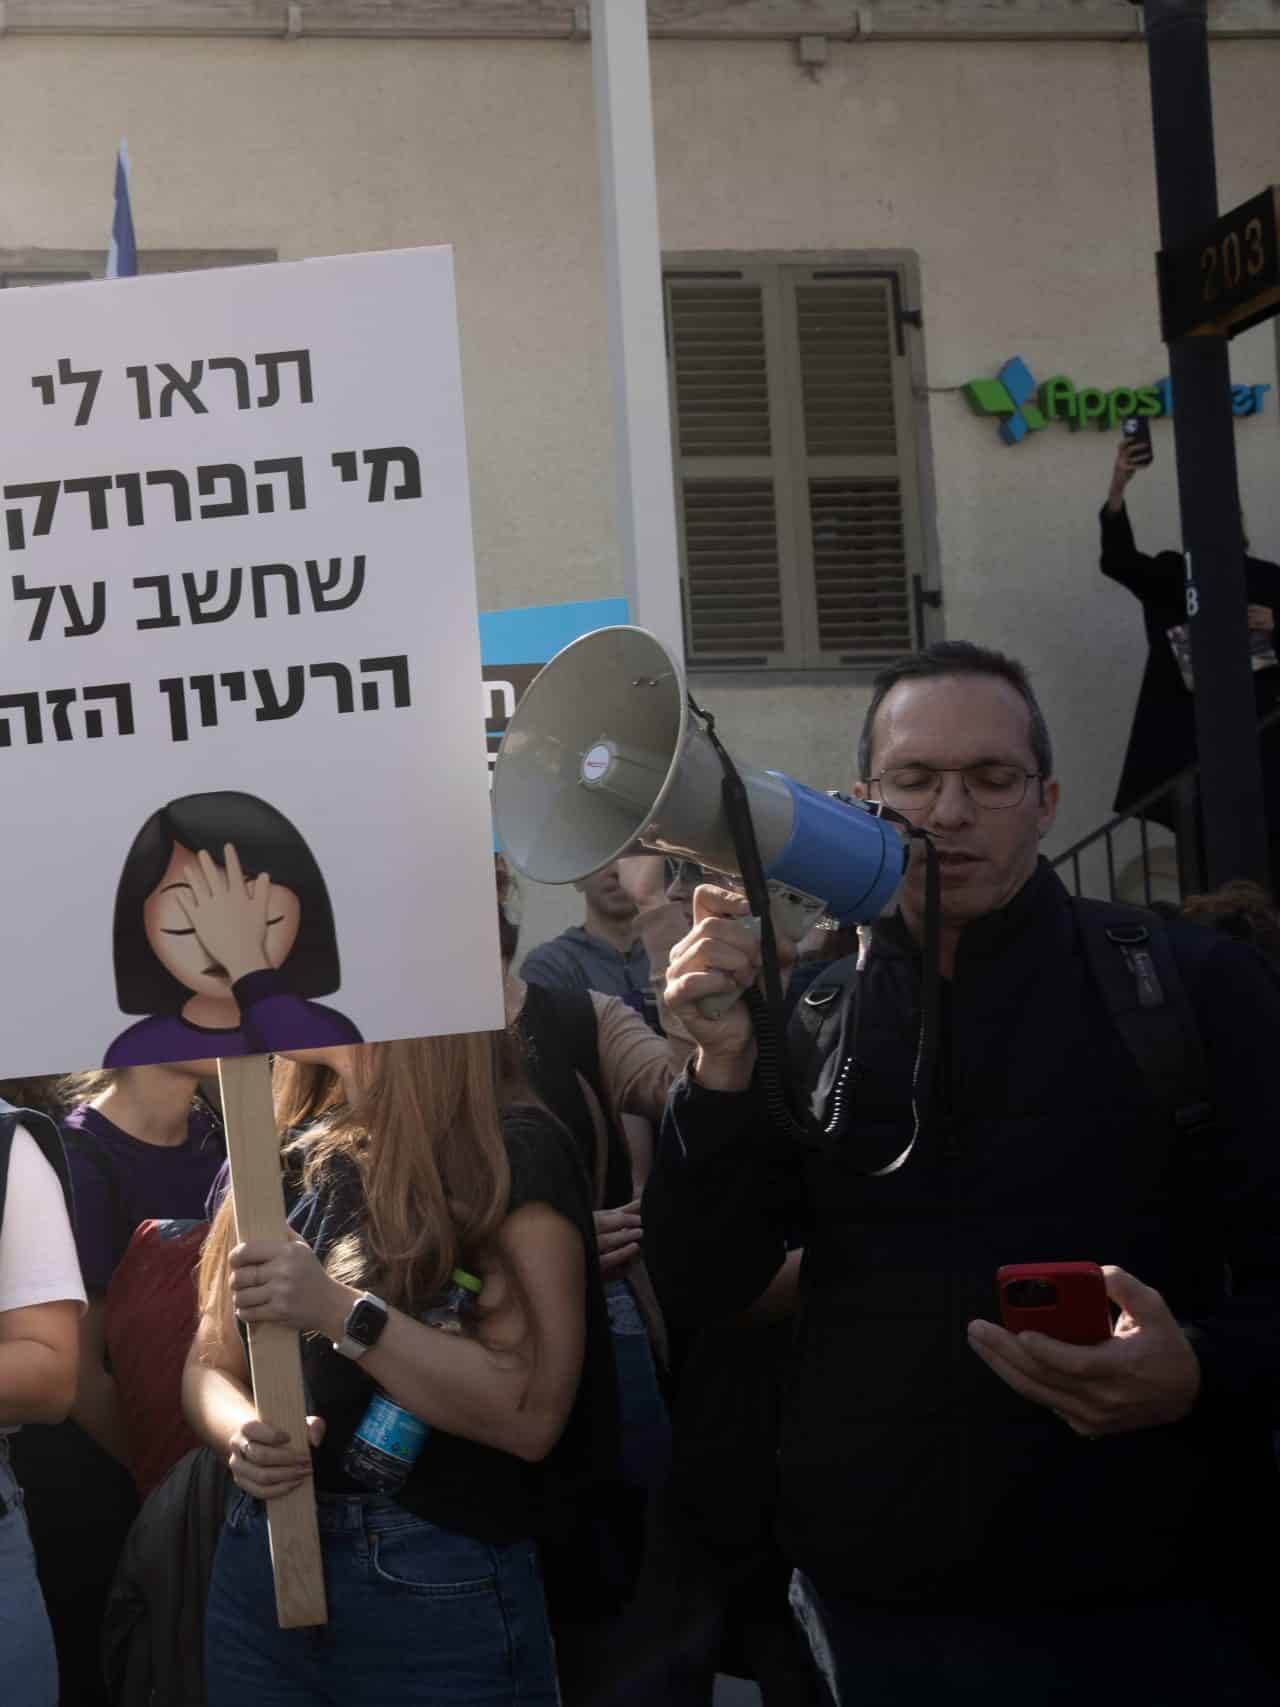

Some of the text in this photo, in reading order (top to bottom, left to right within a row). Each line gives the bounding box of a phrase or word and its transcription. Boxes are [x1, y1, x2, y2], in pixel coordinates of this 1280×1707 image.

[31, 348, 315, 427] תראו לי
[330, 445, 423, 504] מי
[11, 554, 367, 642] שחשב על
[158, 654, 412, 743] הרעיון
